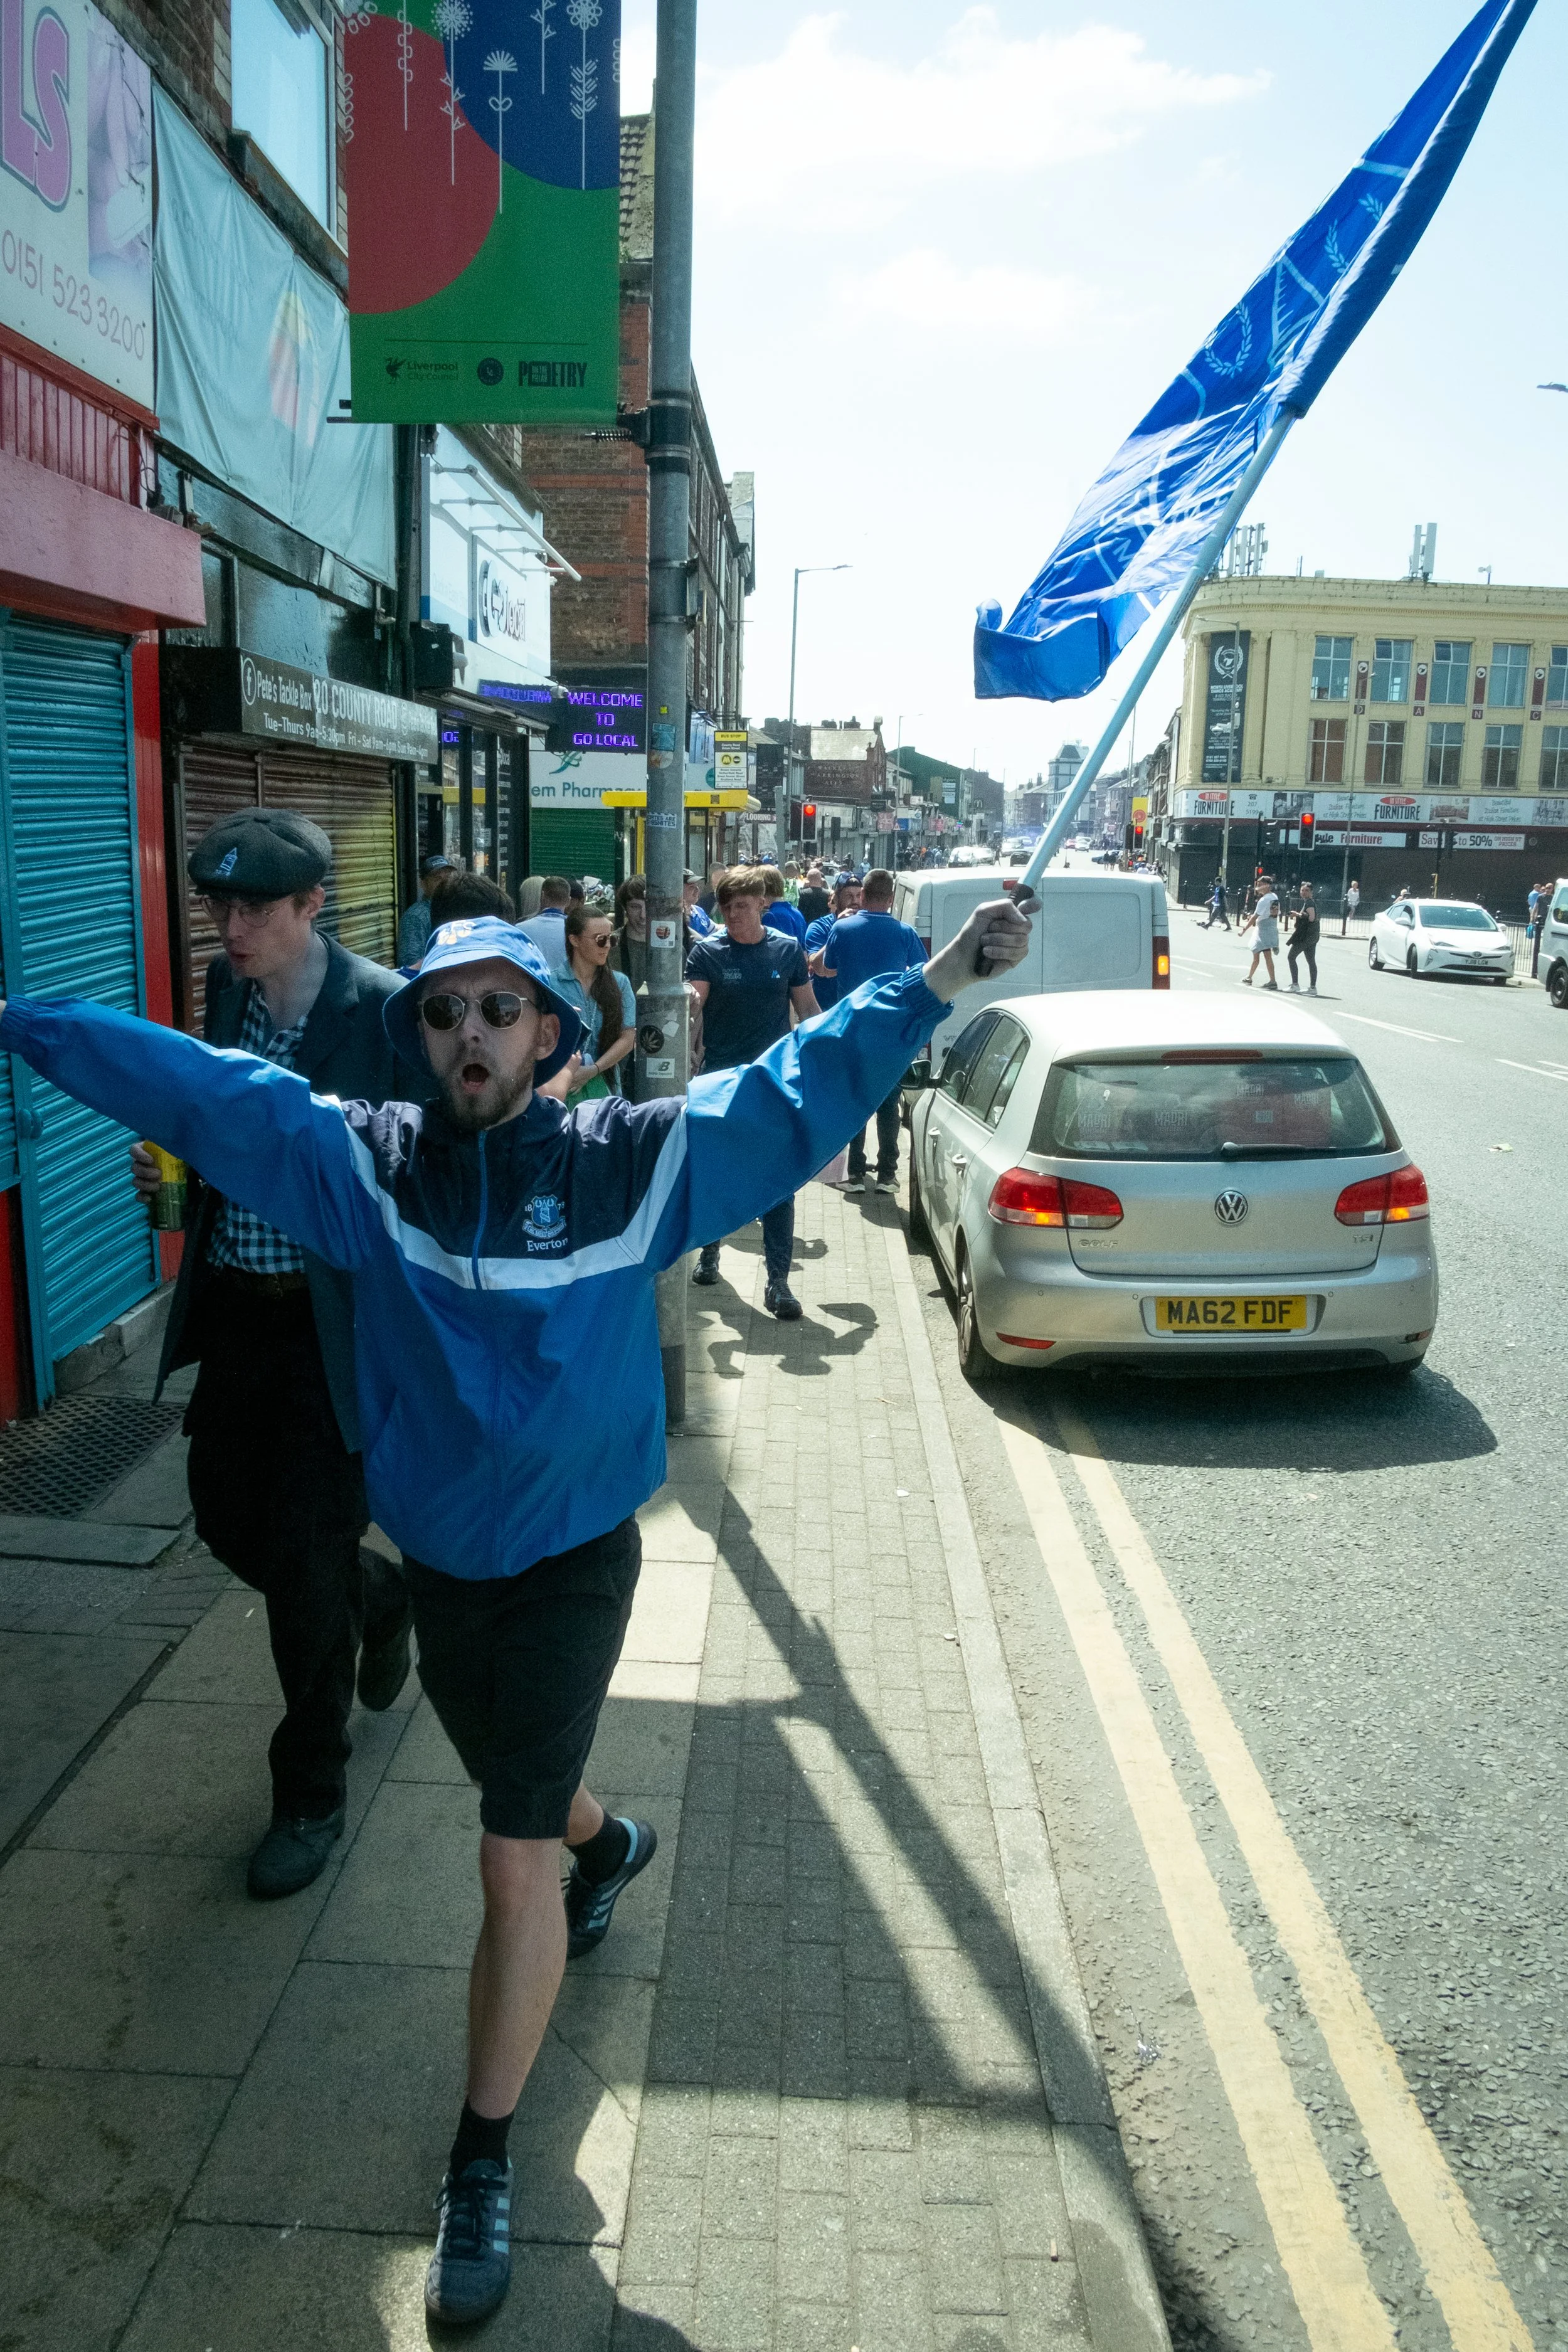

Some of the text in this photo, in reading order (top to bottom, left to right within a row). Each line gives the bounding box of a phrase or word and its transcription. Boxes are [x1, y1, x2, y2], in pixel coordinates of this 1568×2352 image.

[3, 230, 43, 297] 0151
[407, 362, 458, 372] Liverpool
[518, 361, 588, 387] POETRY
[257, 670, 277, 703] Pete's
[278, 676, 299, 707] Tackle
[300, 684, 312, 711] Box
[332, 684, 371, 726] COUNTY
[374, 696, 398, 730] ROAD
[568, 692, 643, 707] WELCOME
[596, 713, 615, 726] TO
[263, 712, 304, 736] Tue-Thurs
[348, 731, 356, 745] Fri
[573, 733, 638, 747] GO LOCAL
[1194, 800, 1235, 815] FURNITUE
[1374, 803, 1421, 821] FURNITURE
[744, 813, 771, 821] FLOORING
[1458, 837, 1466, 846] to
[1469, 835, 1493, 847] 50%
[527, 1237, 568, 1251] Everton
[1079, 1239, 1118, 1248] GOLF
[1167, 1300, 1293, 1324] MA62 FDF
